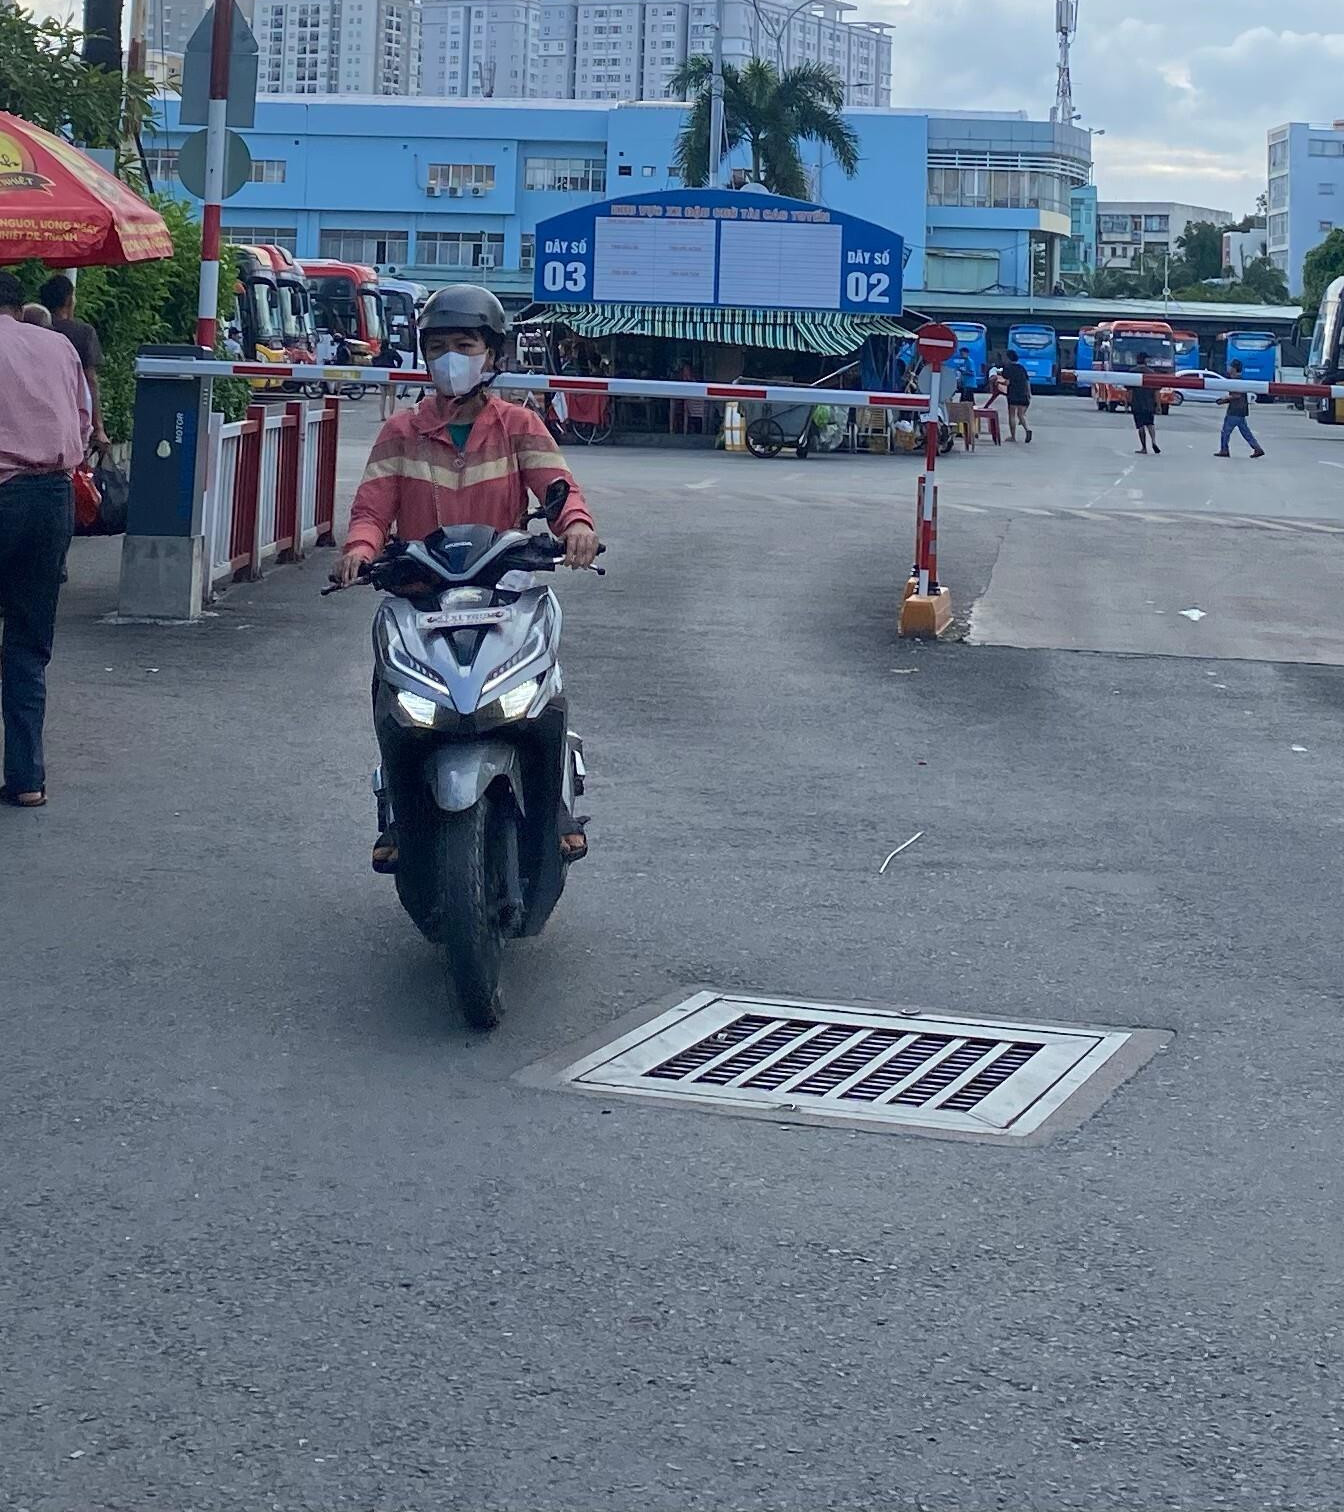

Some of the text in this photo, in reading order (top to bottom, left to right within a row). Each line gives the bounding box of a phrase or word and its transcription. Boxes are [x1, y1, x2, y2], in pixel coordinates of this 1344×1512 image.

[570, 237, 587, 254] SỐ
[544, 261, 586, 292] 03
[847, 271, 890, 303] 02
